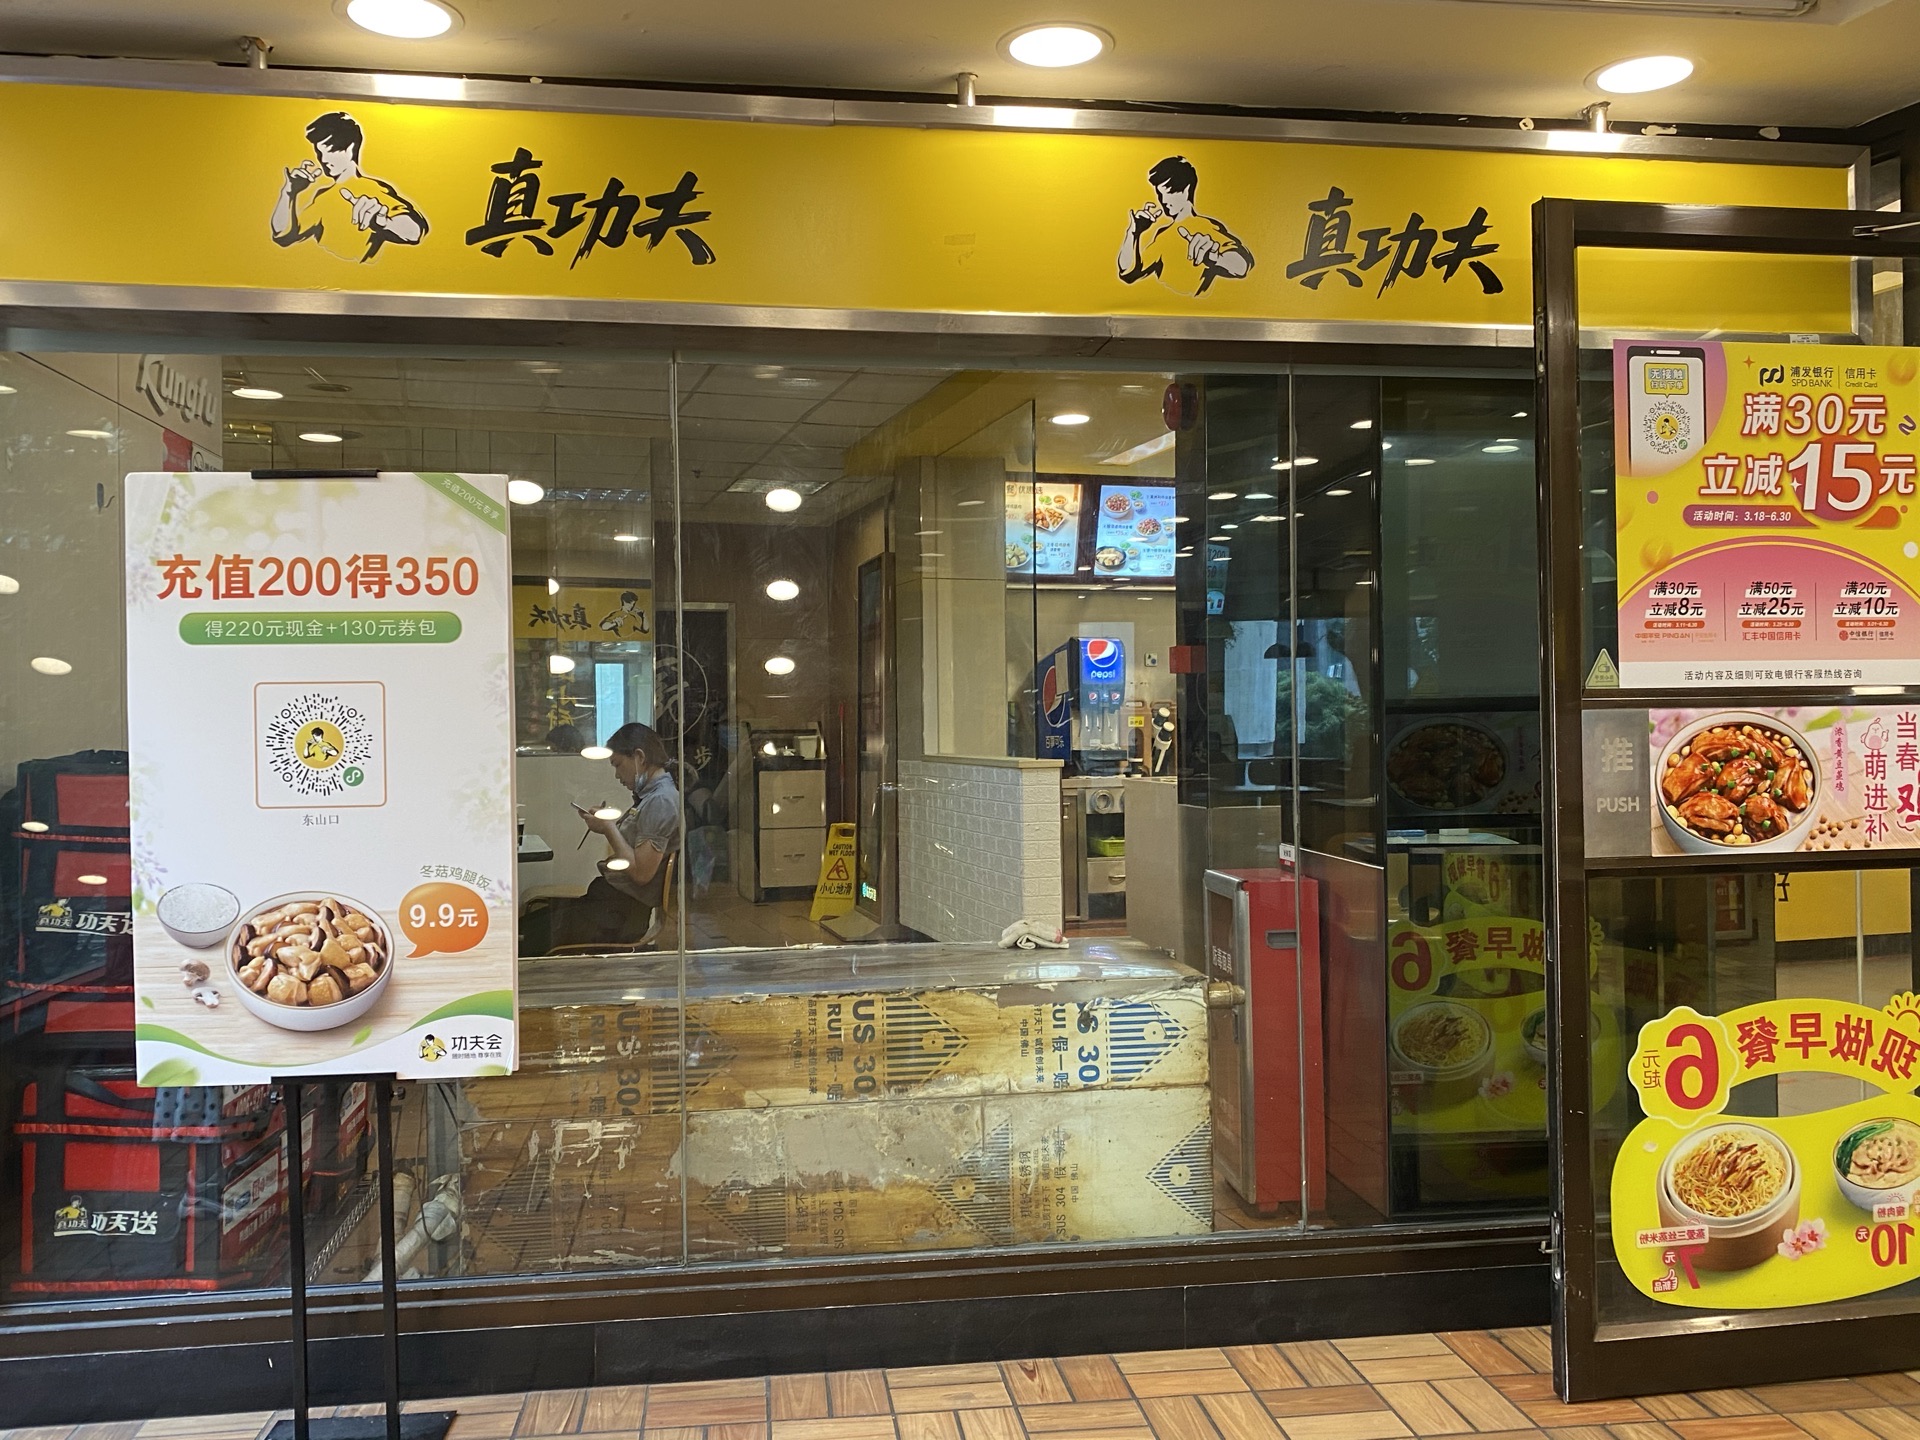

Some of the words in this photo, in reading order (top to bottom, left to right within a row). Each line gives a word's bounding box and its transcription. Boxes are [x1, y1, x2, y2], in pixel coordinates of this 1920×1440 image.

[465, 146, 717, 270] 真功夫
[1285, 186, 1504, 299] 真功夫
[1651, 368, 1684, 380] 无接触
[1790, 366, 1834, 379] 浦发银行
[1845, 367, 1877, 380] 信用卡
[1809, 379, 1833, 388] BANK
[1742, 393, 1887, 436] 满30元
[156, 553, 480, 600] 充值200得350
[1653, 581, 1699, 596] 满30元
[1749, 581, 1793, 595] 满50元
[1844, 581, 1888, 595] 满20元
[1650, 597, 1704, 616] 立减8元
[1738, 597, 1804, 616] 立减25元
[1834, 597, 1898, 616] 立减10元
[204, 618, 437, 639] 得220元现金+130元券包
[1742, 631, 1801, 641] 汇丰中国信用卡
[1090, 669, 1116, 680] pepsi
[1684, 668, 1863, 681] 活动内容及细则可致电银行客服热线咨询
[1601, 737, 1634, 774] 推
[1596, 796, 1640, 813] PUSH
[1864, 748, 1889, 842] 萌进补
[301, 813, 340, 827] 东山口
[420, 864, 492, 892] 冬菇鸡腿饭
[819, 882, 853, 896] 小心地滑
[408, 903, 479, 929] 9.9元
[1033, 1004, 1043, 1035] 打天下
[451, 1033, 503, 1051] 功夫会
[1035, 1037, 1045, 1084] 诚信创未来
[1056, 1186, 1066, 1207] 304
[1070, 1186, 1079, 1204] 中国
[833, 1200, 845, 1221] 304
[91, 1211, 158, 1235] 功夫送
[1056, 1214, 1066, 1235] SUS
[833, 1228, 845, 1249] SUS
